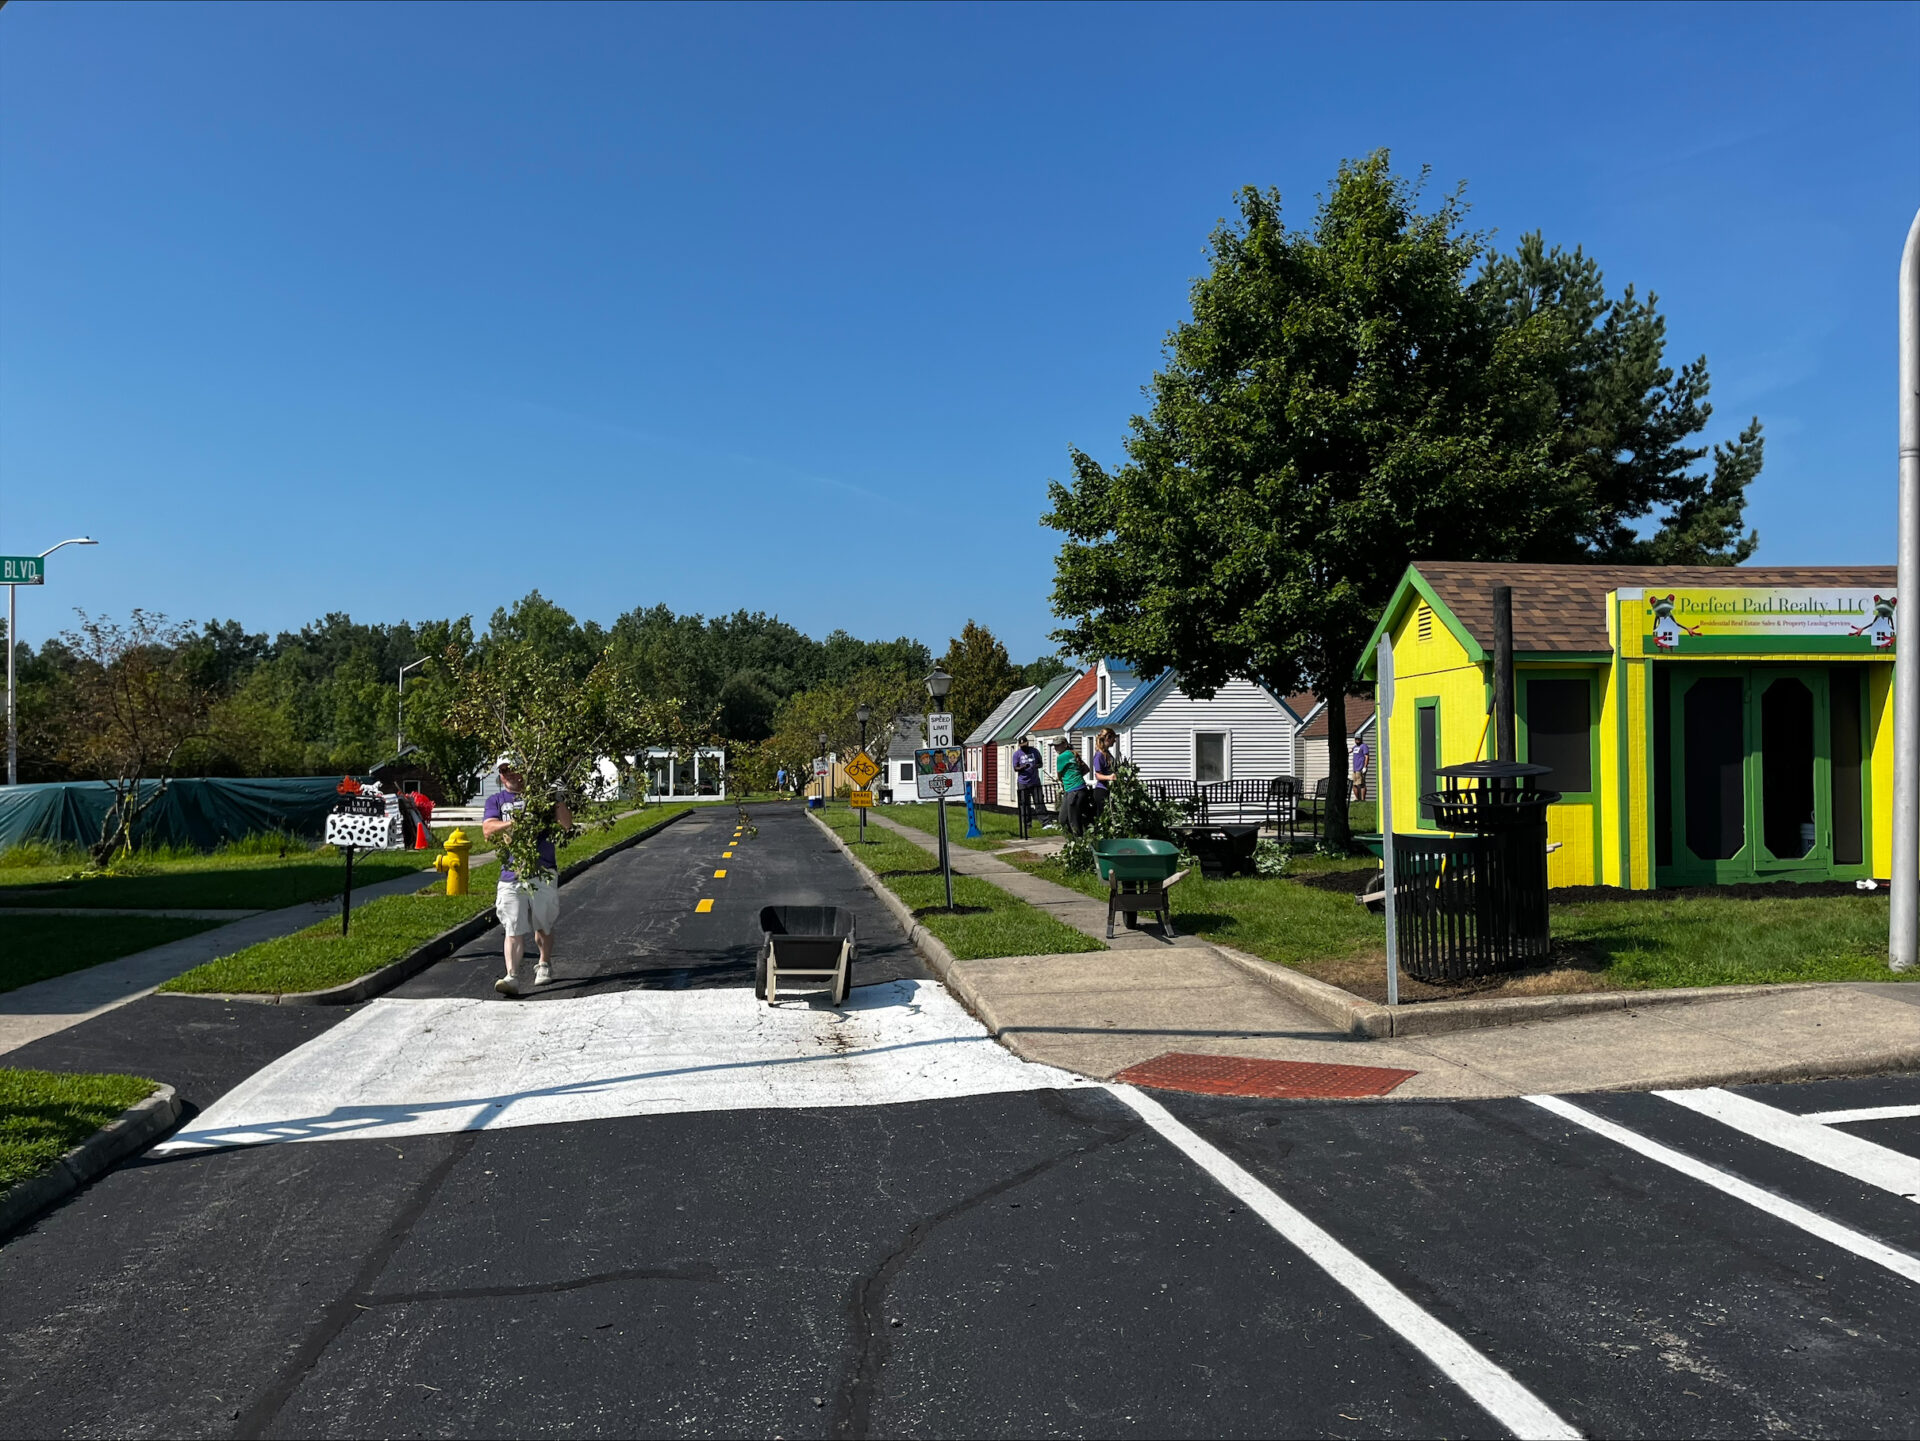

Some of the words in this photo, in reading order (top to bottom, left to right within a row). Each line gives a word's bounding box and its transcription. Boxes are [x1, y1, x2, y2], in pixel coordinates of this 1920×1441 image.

[4, 560, 36, 578] BLVD
[1680, 596, 1736, 613] Perfect
[1743, 597, 1772, 613] Pad
[1778, 597, 1832, 617] Realty,
[1838, 598, 1869, 613] LLC
[1782, 620, 1806, 628] Property
[1807, 620, 1828, 628] Leasing
[933, 735, 949, 746] 10
